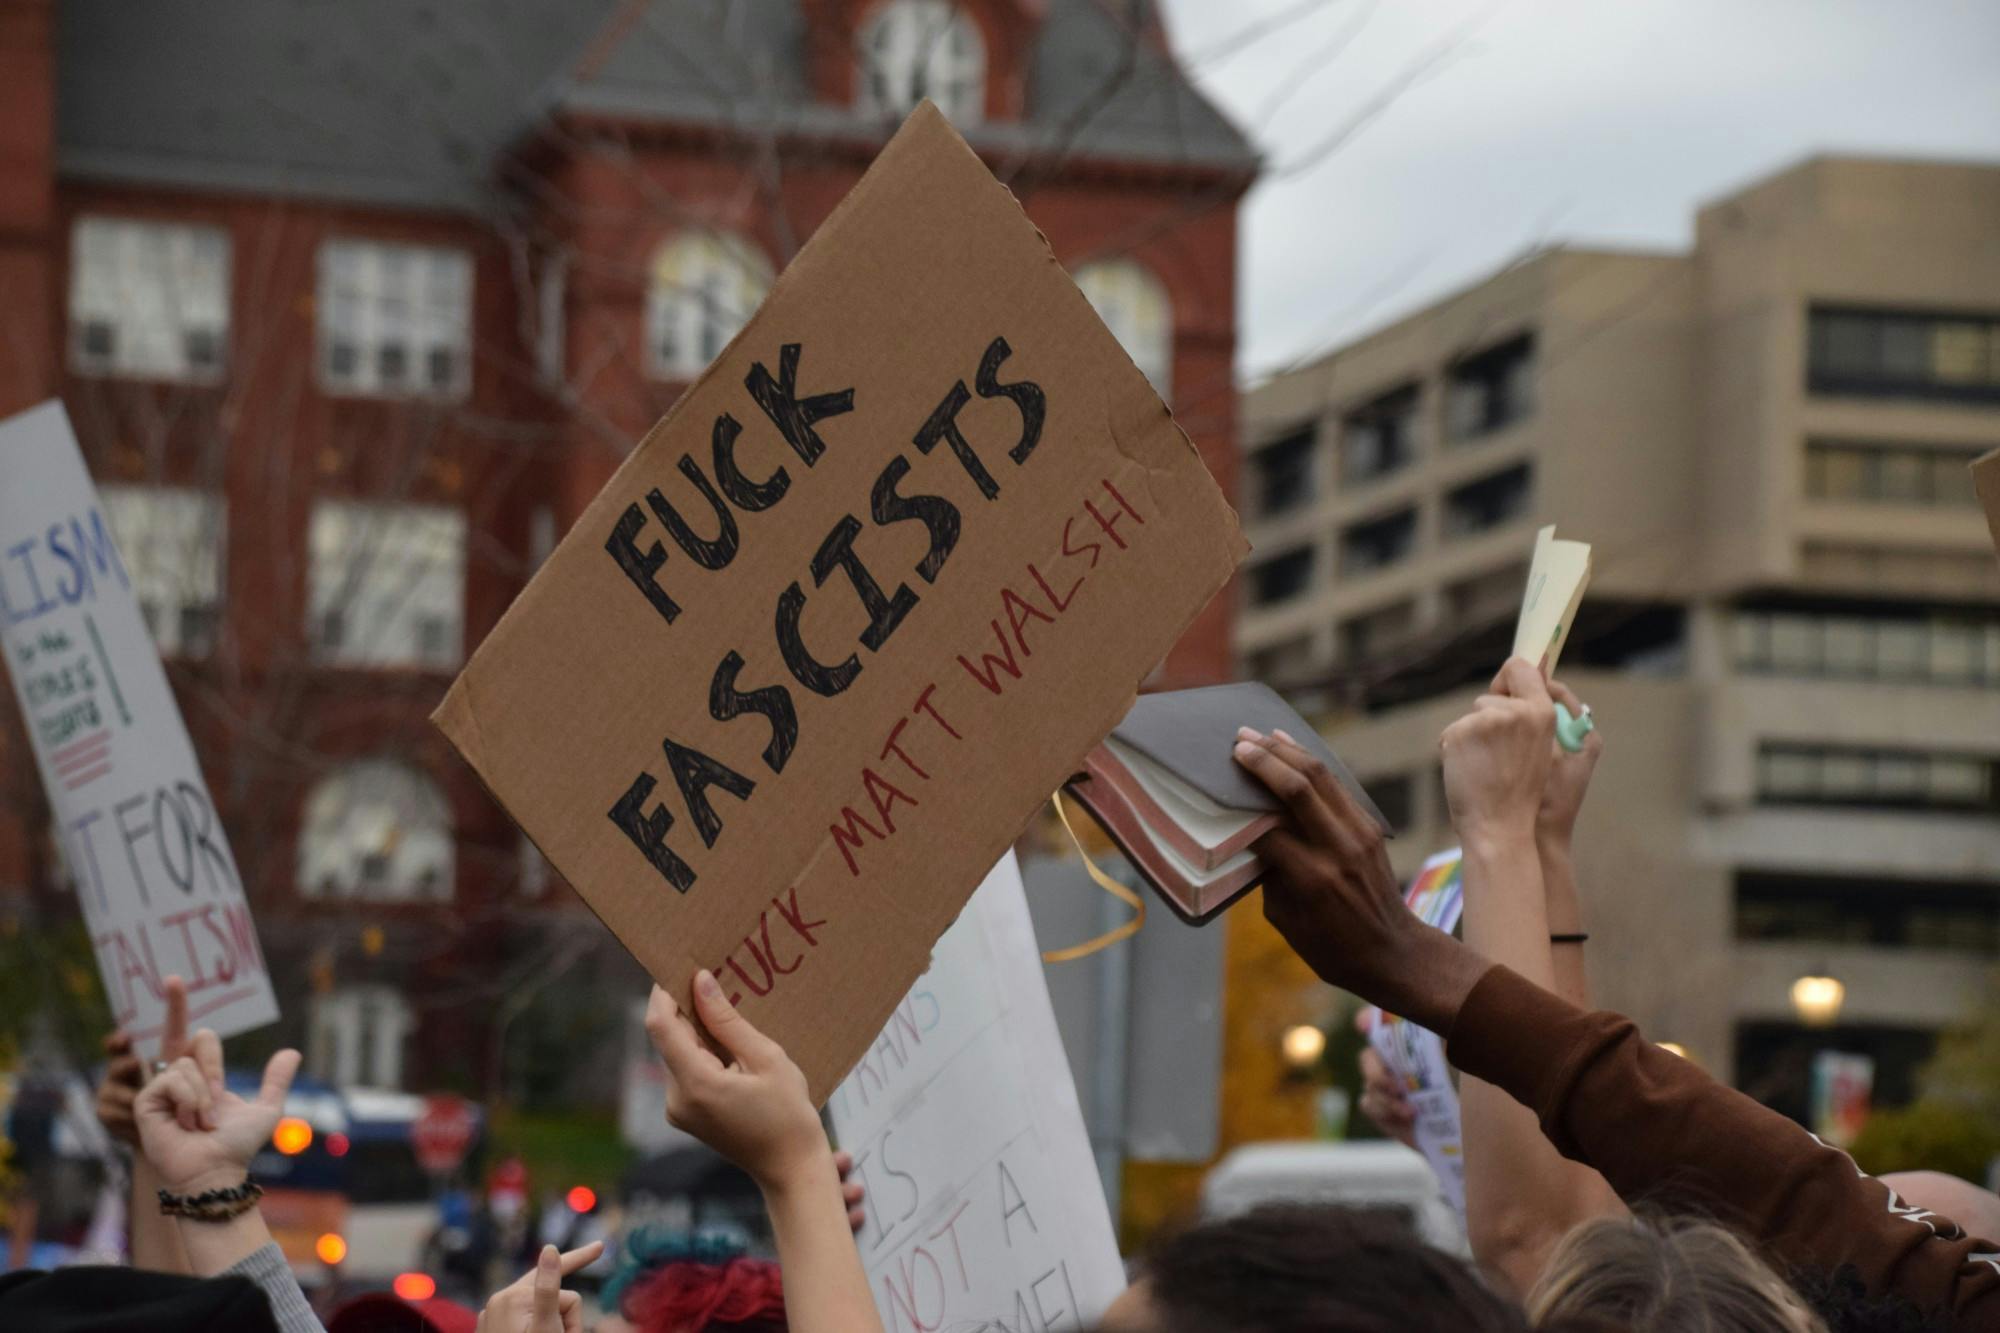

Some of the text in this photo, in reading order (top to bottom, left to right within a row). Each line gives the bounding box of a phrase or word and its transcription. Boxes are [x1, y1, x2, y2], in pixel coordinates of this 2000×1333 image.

[605, 343, 855, 625] FUCK
[607, 335, 1046, 895] FASCISTS
[829, 683, 962, 877] MATT
[956, 478, 1145, 695] WALSH
[113, 779, 240, 909] FOR
[853, 1129, 919, 1250] IS
[884, 1160, 1038, 1333] NOT A
